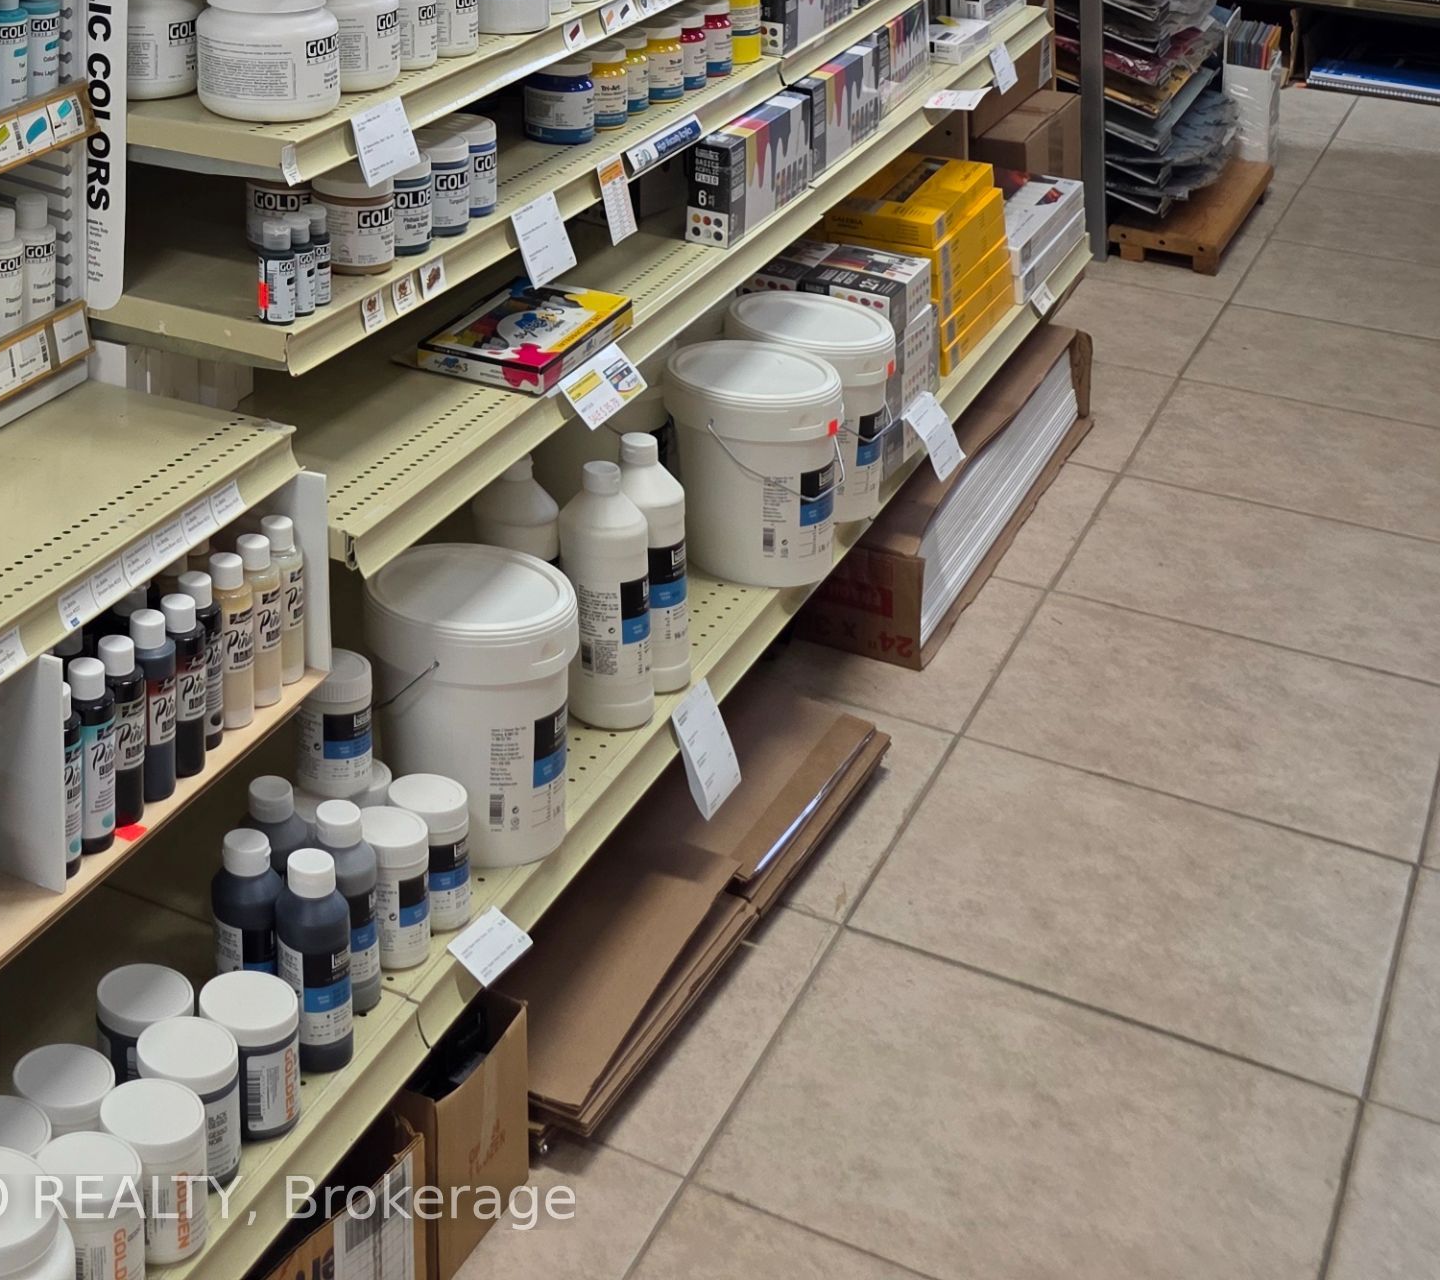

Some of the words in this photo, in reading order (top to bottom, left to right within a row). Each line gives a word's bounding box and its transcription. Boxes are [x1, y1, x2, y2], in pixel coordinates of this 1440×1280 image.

[88, 57, 112, 213] COLORS
[254, 190, 310, 212] GOLDE
[698, 190, 708, 206] 6
[283, 1046, 295, 1122] GOLDEN
[176, 1171, 191, 1250] GOLDEN
